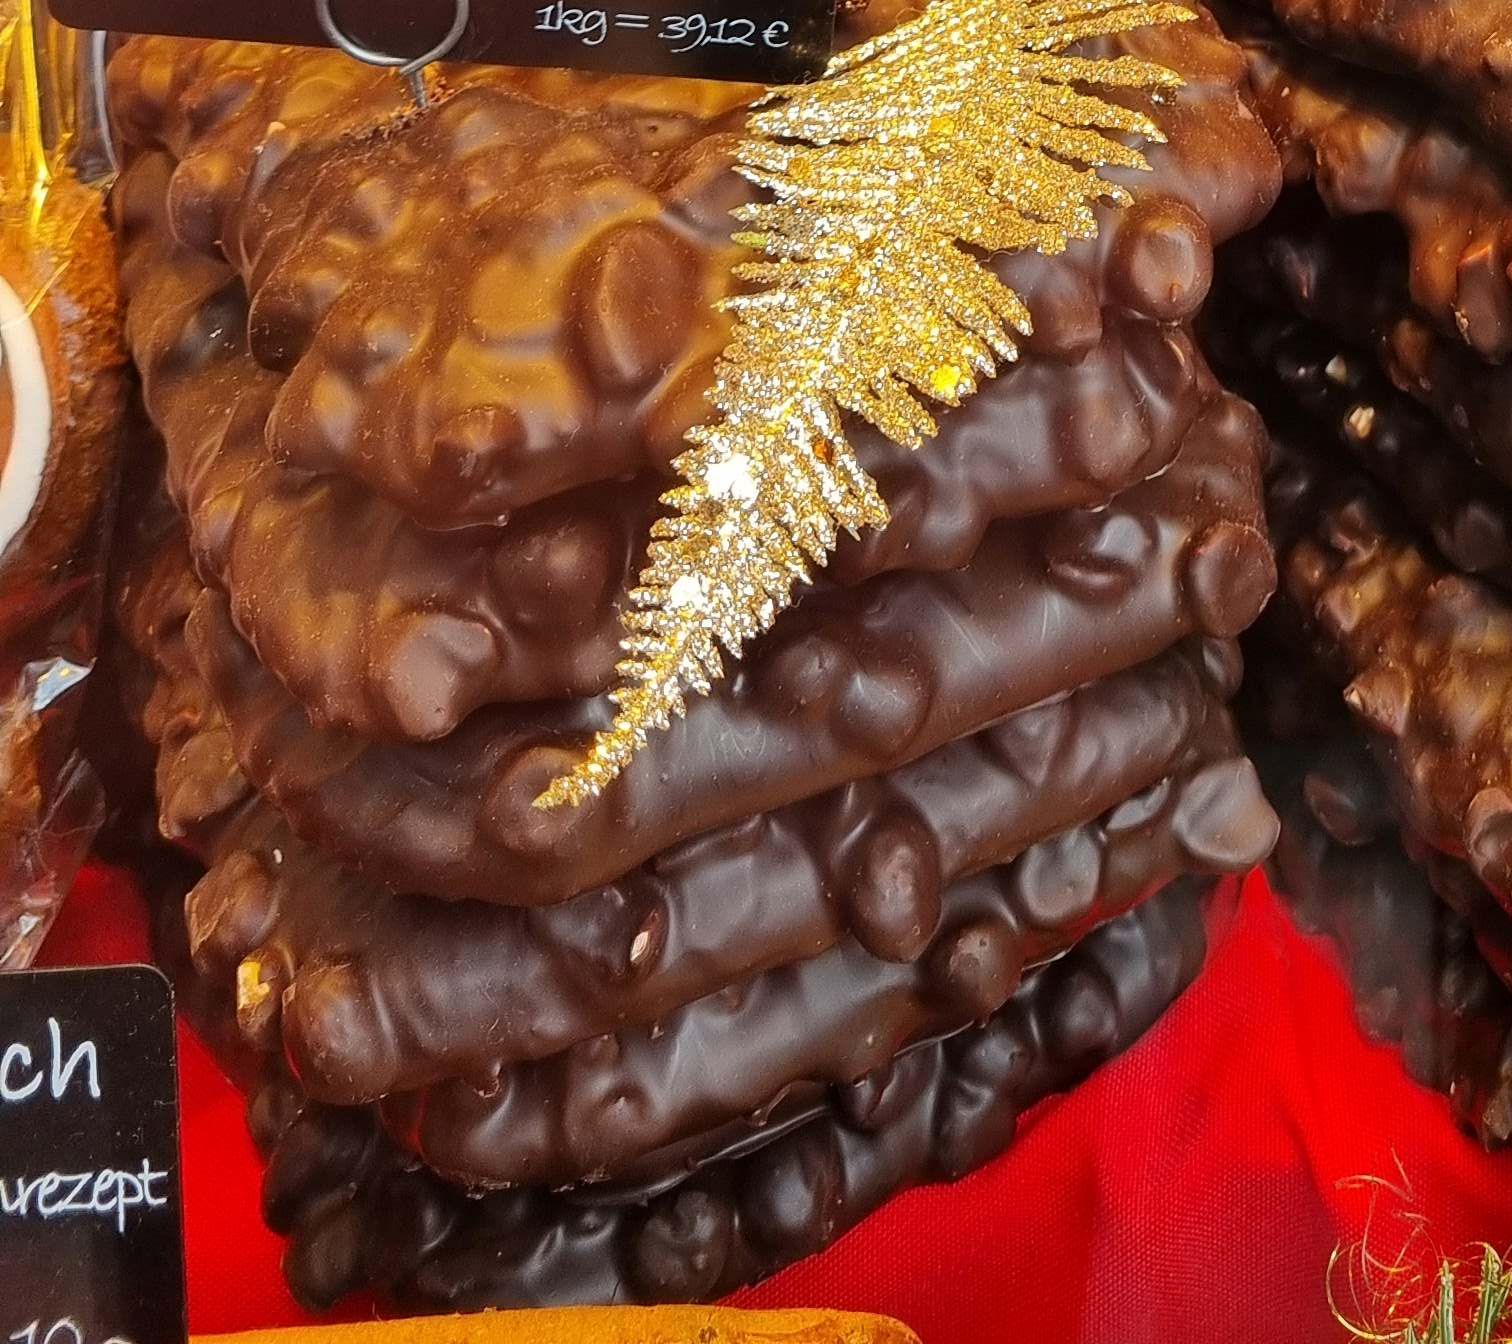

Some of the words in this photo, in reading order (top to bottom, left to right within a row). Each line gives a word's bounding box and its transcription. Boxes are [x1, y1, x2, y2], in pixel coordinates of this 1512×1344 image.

[534, 0, 608, 46] 1kg
[656, 16, 757, 54] 39,12
[761, 19, 790, 49] €
[0, 1015, 101, 1102] ch
